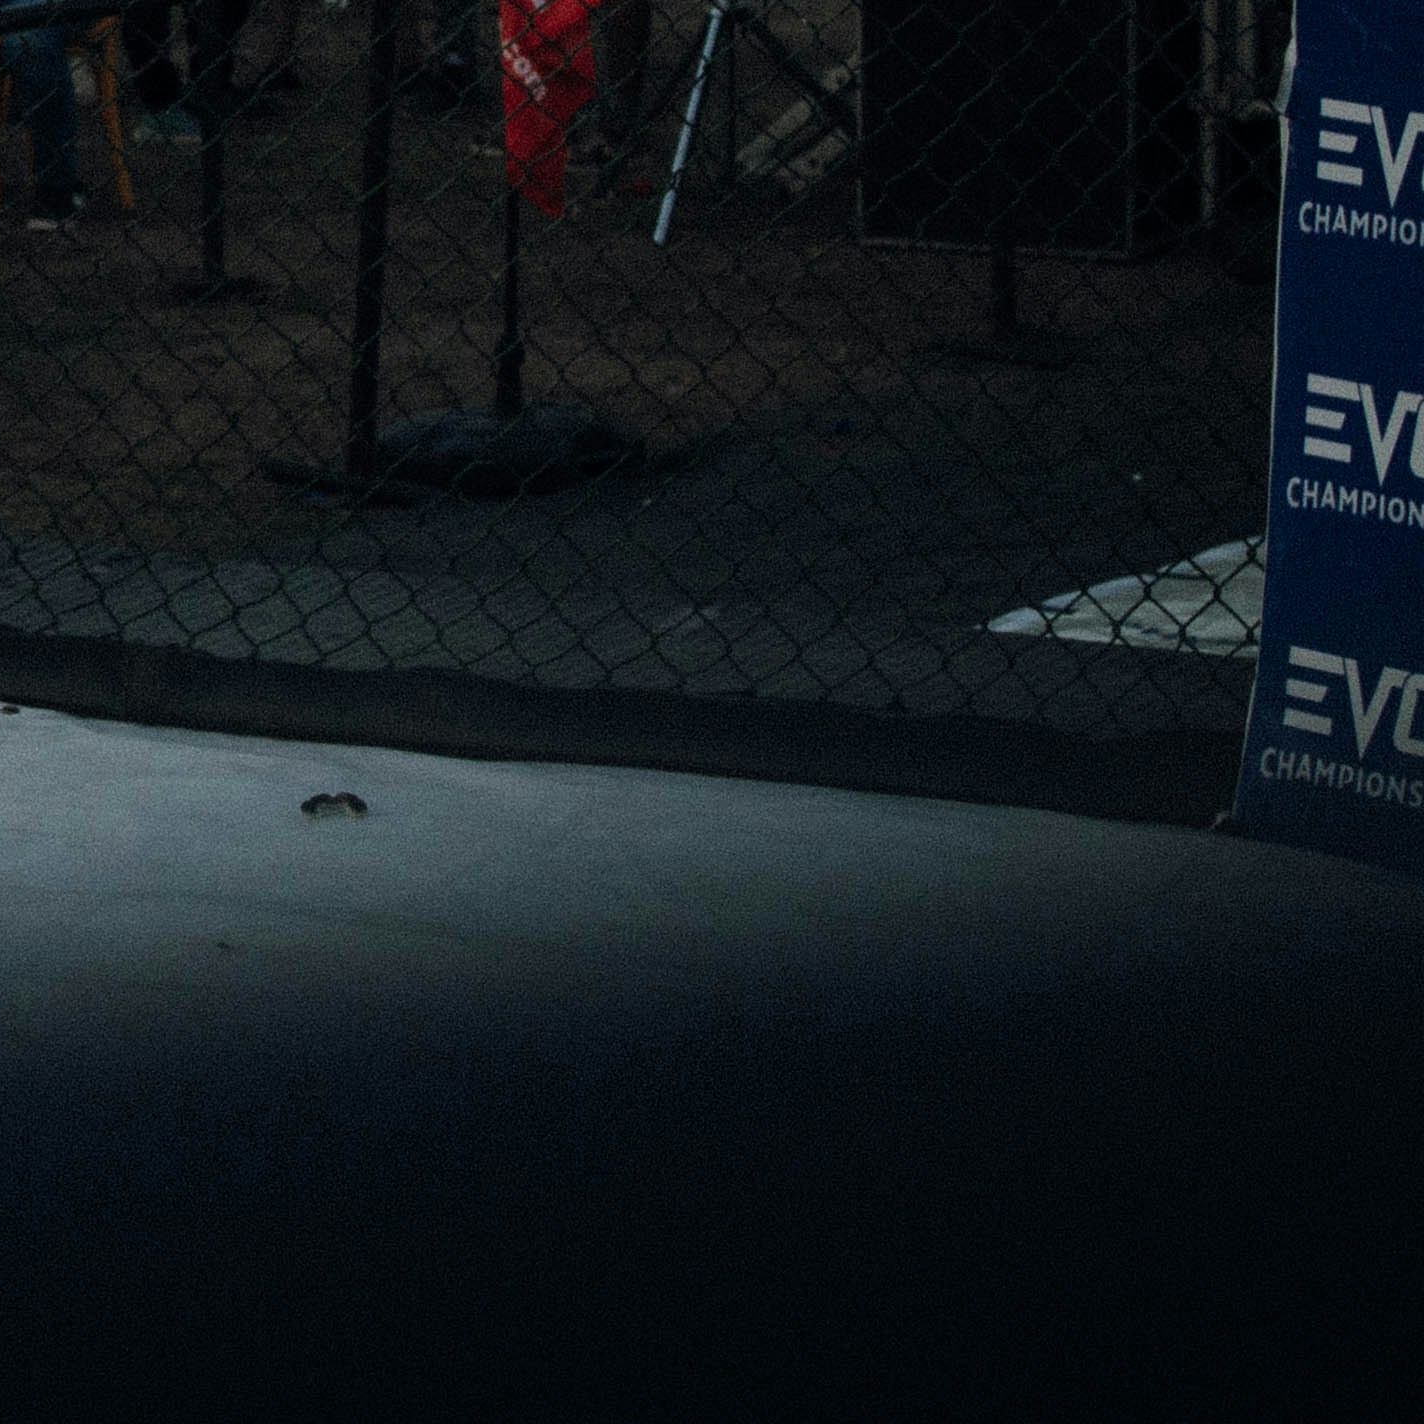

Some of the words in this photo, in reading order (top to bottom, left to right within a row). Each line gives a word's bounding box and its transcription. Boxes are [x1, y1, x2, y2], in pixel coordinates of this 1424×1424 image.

[1316, 97, 1424, 210] EV
[1298, 201, 1424, 248] CHAMPIO
[1303, 372, 1424, 488] EV
